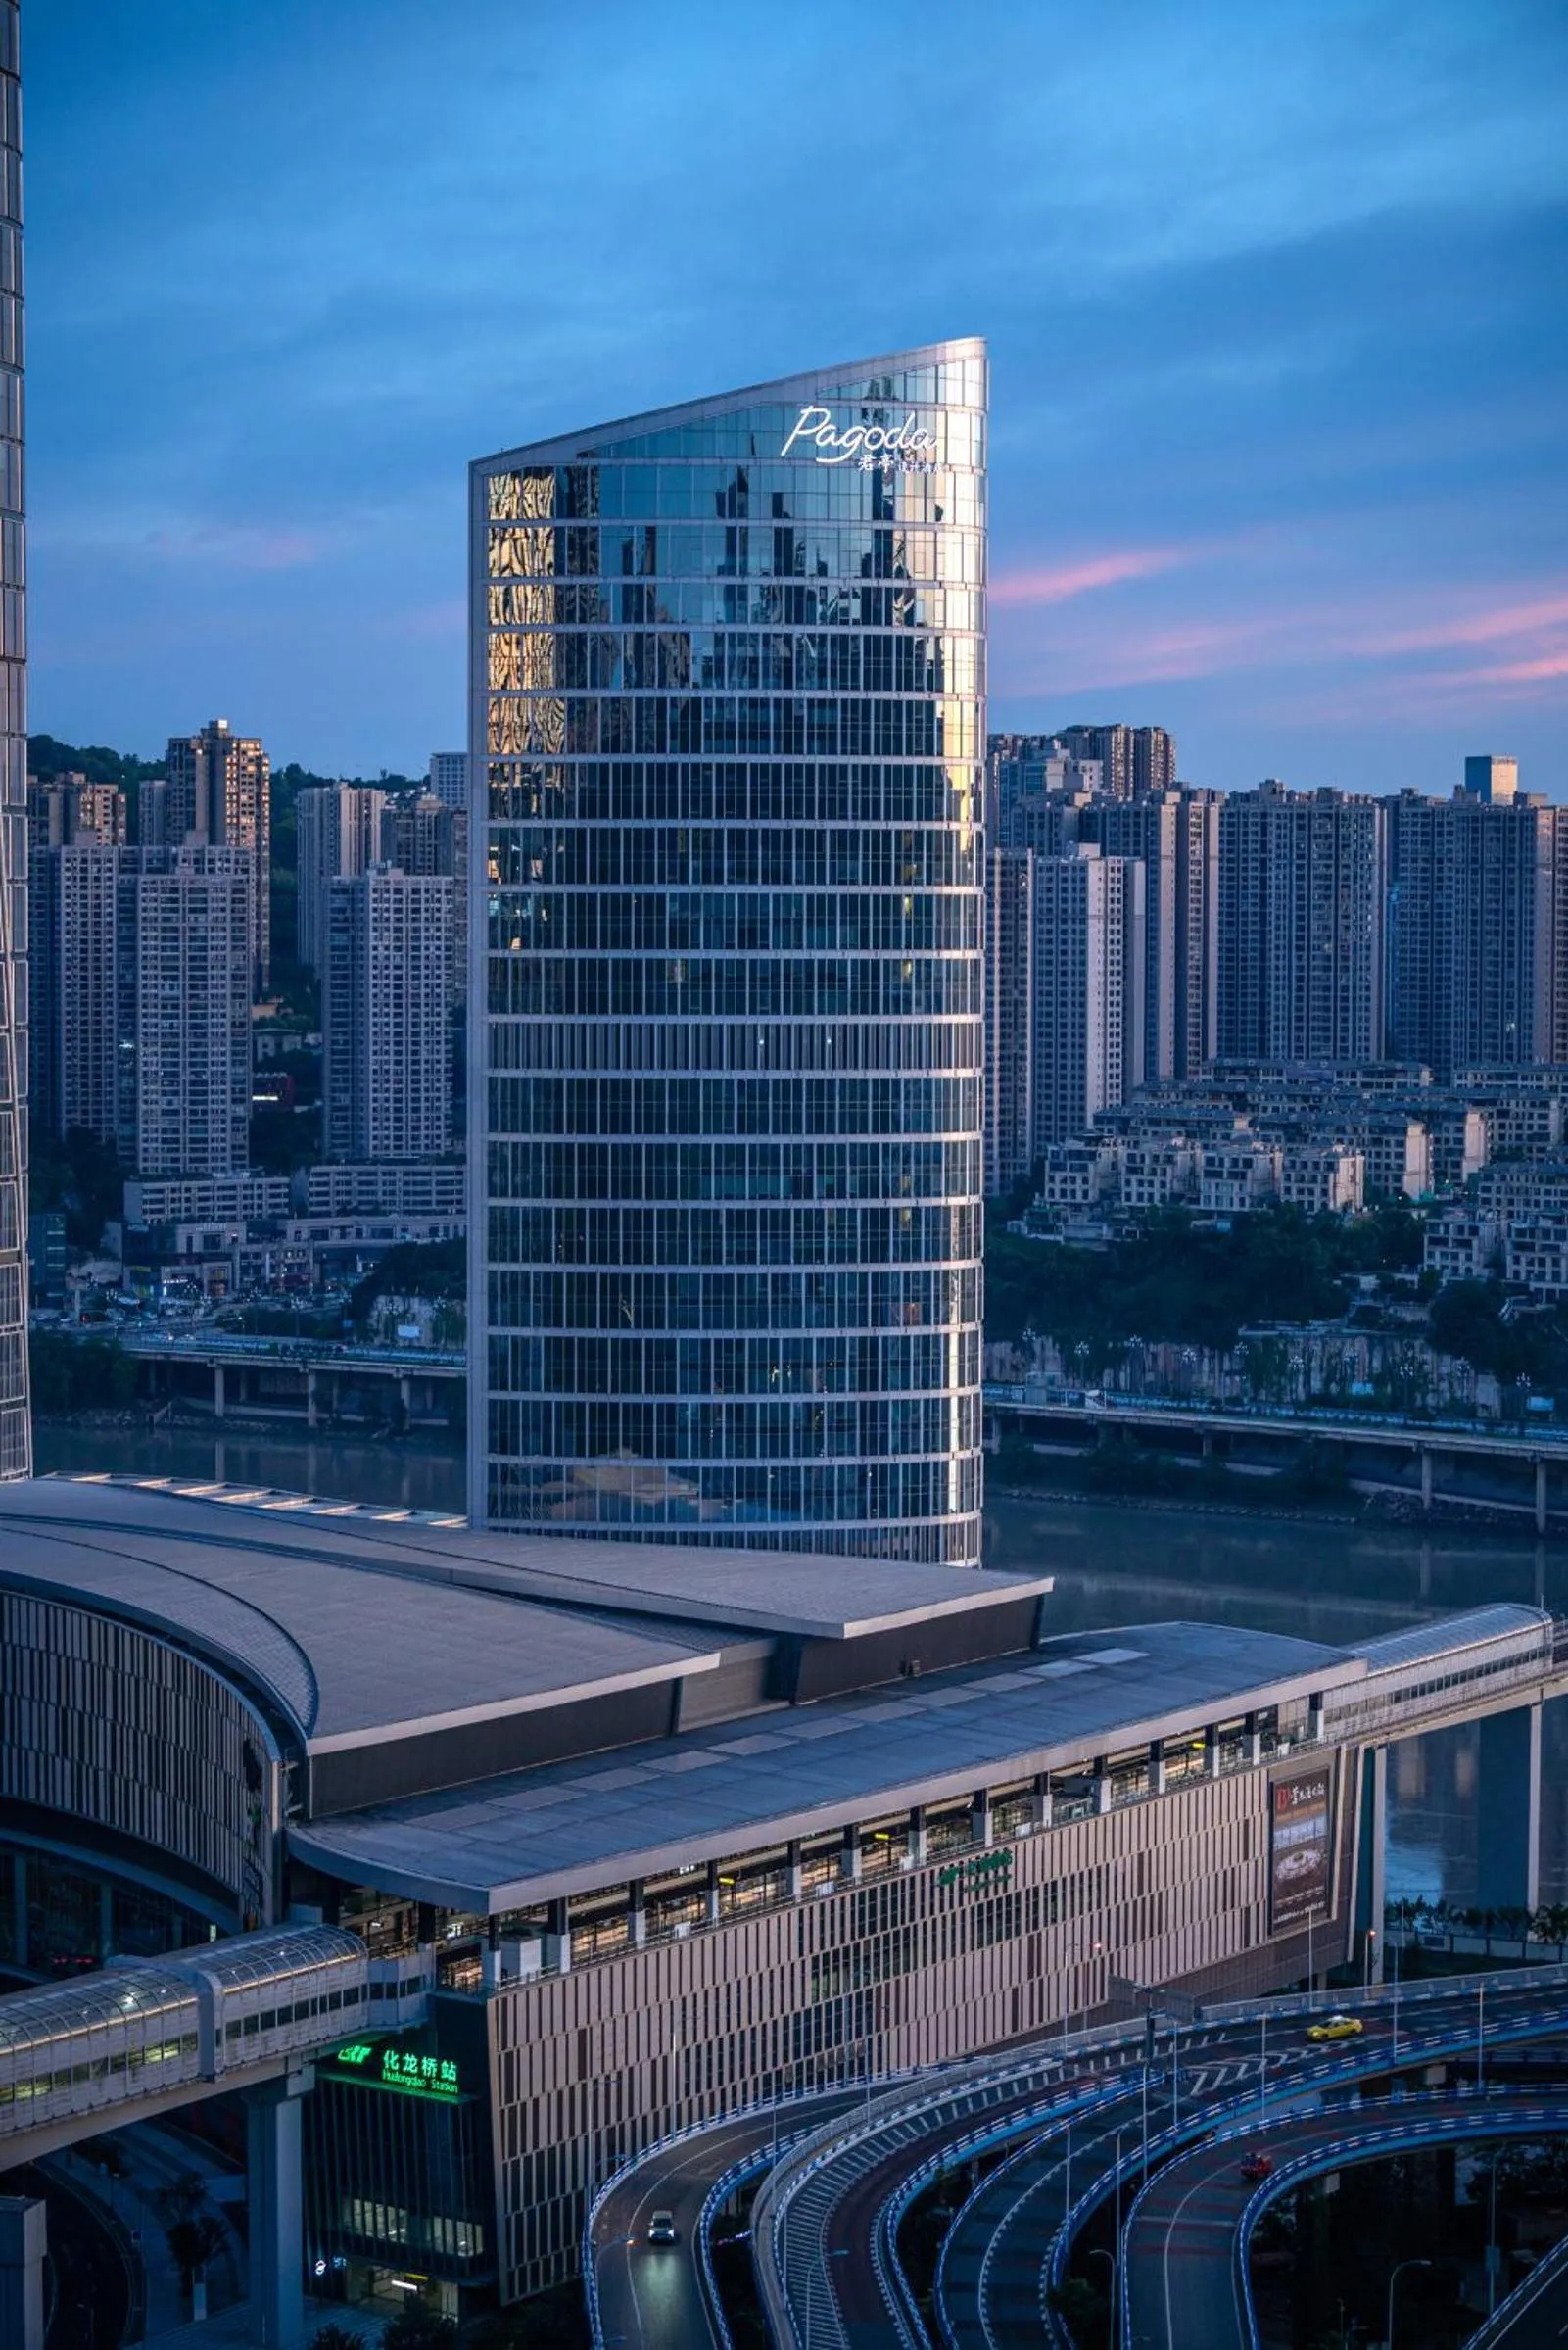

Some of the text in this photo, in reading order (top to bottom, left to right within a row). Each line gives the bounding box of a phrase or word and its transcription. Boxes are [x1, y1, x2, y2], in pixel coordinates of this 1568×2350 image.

[781, 405, 937, 462] Pagoda
[383, 2050, 457, 2082] 化龙桥站
[431, 2079, 458, 2093] Station
